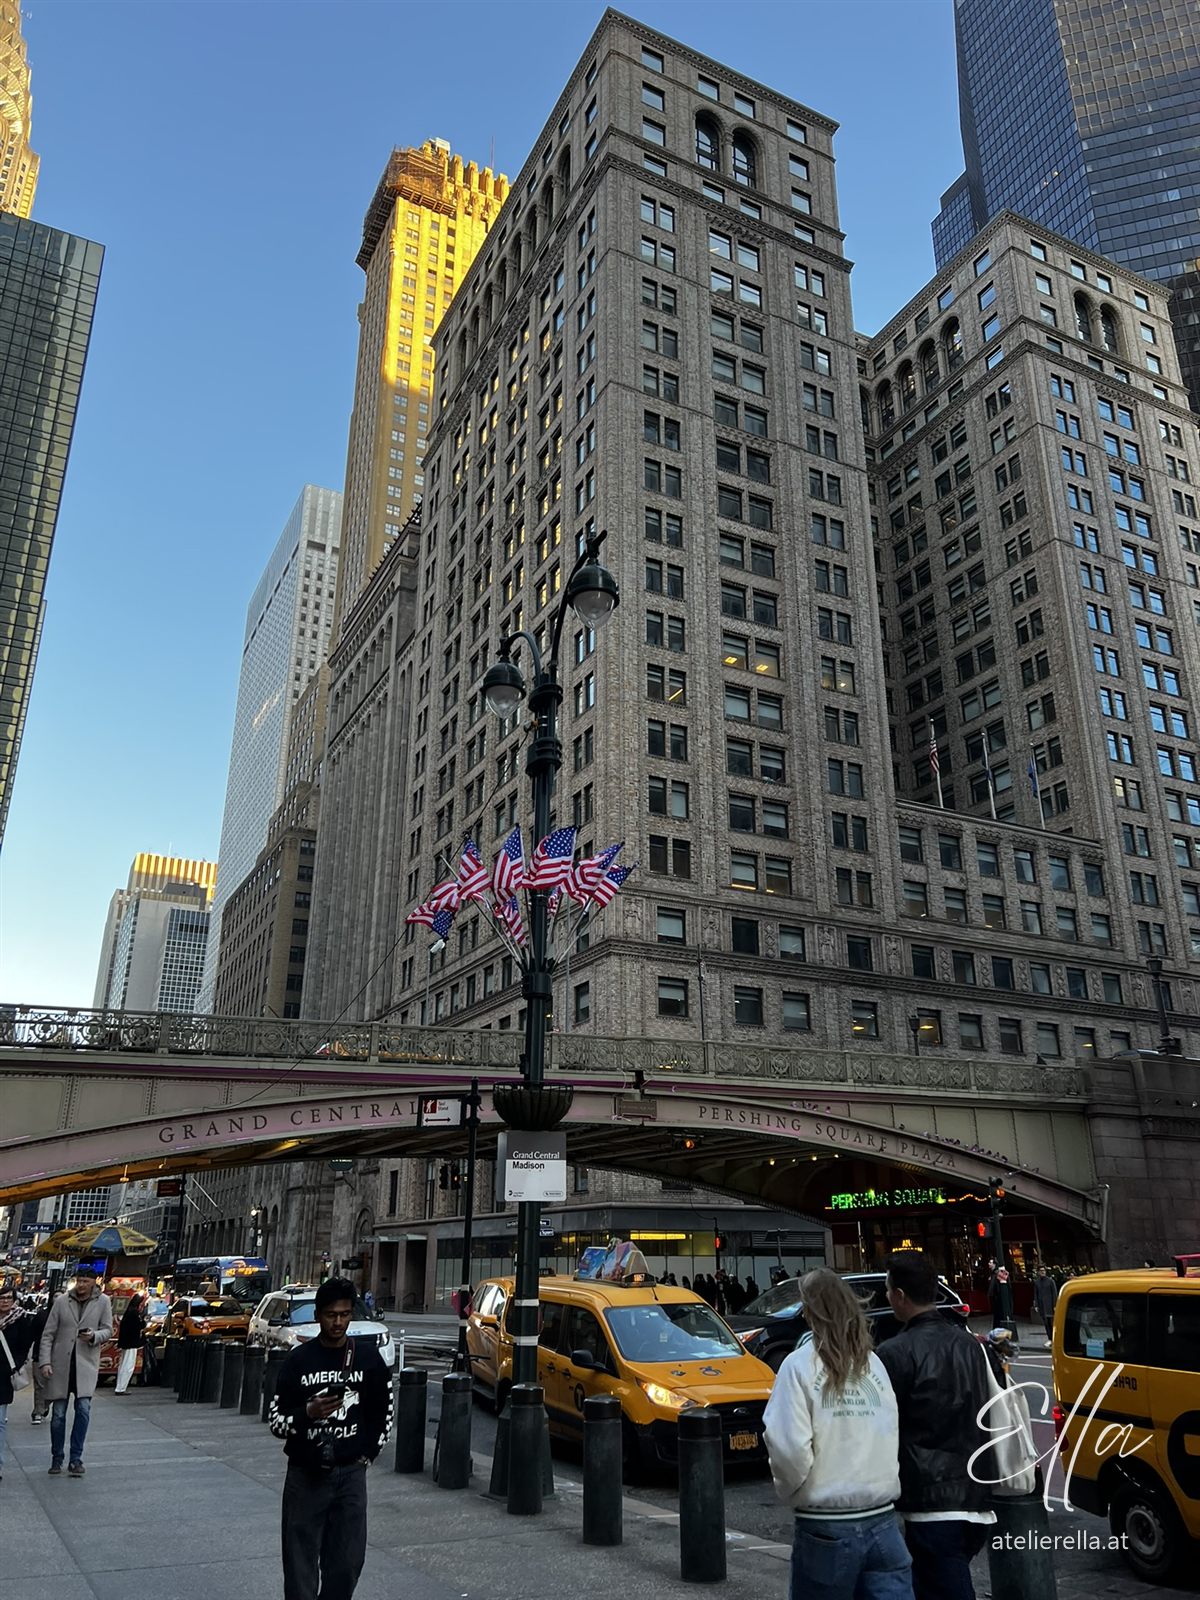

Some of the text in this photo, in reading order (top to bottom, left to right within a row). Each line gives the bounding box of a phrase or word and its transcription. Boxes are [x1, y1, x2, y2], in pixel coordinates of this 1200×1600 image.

[158, 1100, 418, 1144] GRAND CENTRAL
[699, 1105, 957, 1168] PERSHING SQUARE PLAZA
[512, 1150, 560, 1159] Grand Central
[512, 1161, 545, 1169] Madison
